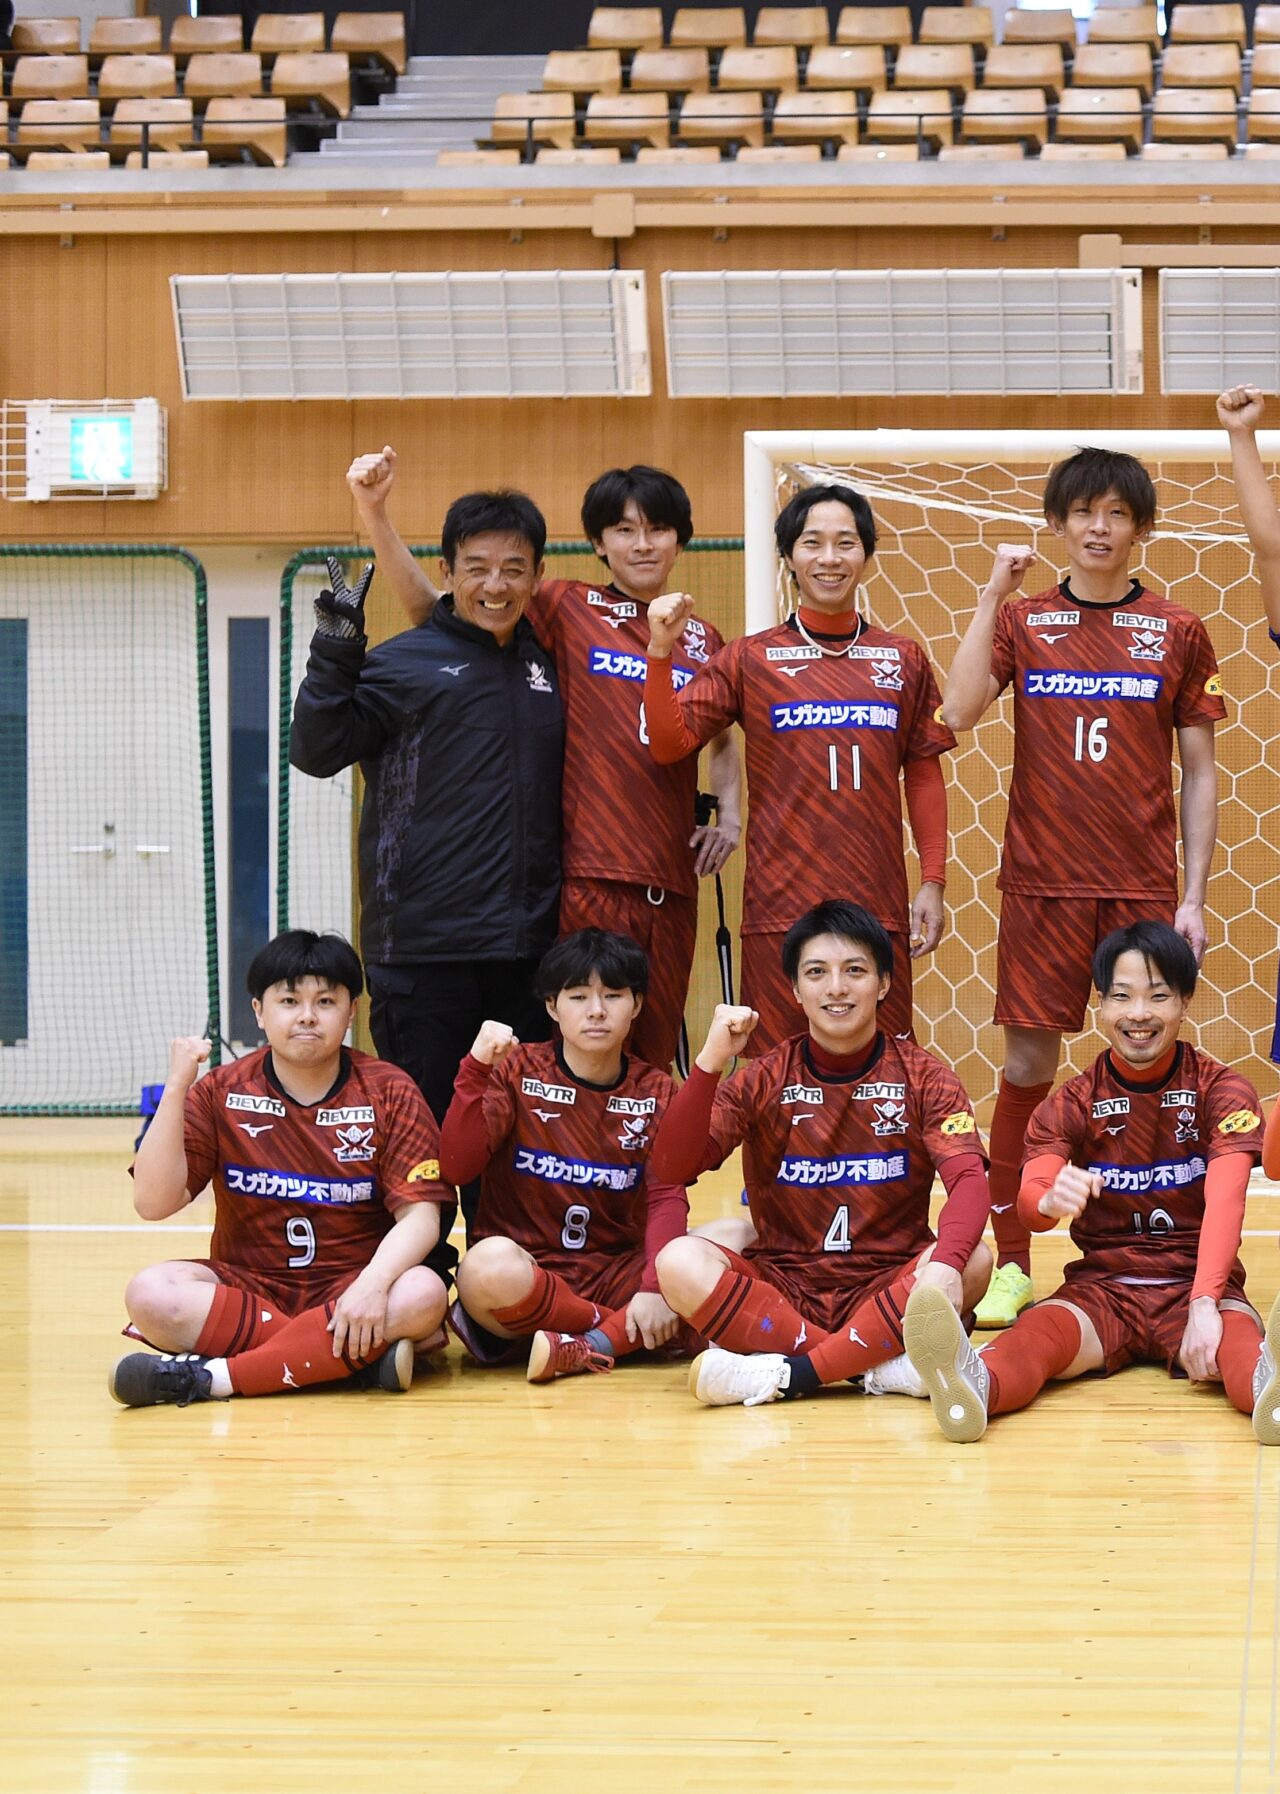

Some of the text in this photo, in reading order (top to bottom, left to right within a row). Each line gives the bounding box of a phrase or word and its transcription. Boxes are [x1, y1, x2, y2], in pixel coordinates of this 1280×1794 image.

[1027, 672, 1159, 699] スガカツ不動産
[774, 703, 900, 730] スガカツ不動産
[1073, 715, 1109, 763] 16
[827, 743, 862, 791] 11
[227, 1168, 373, 1203] スガカツ不動産
[285, 1215, 317, 1269] 9
[561, 1203, 591, 1251] 8
[823, 1204, 852, 1254] 4
